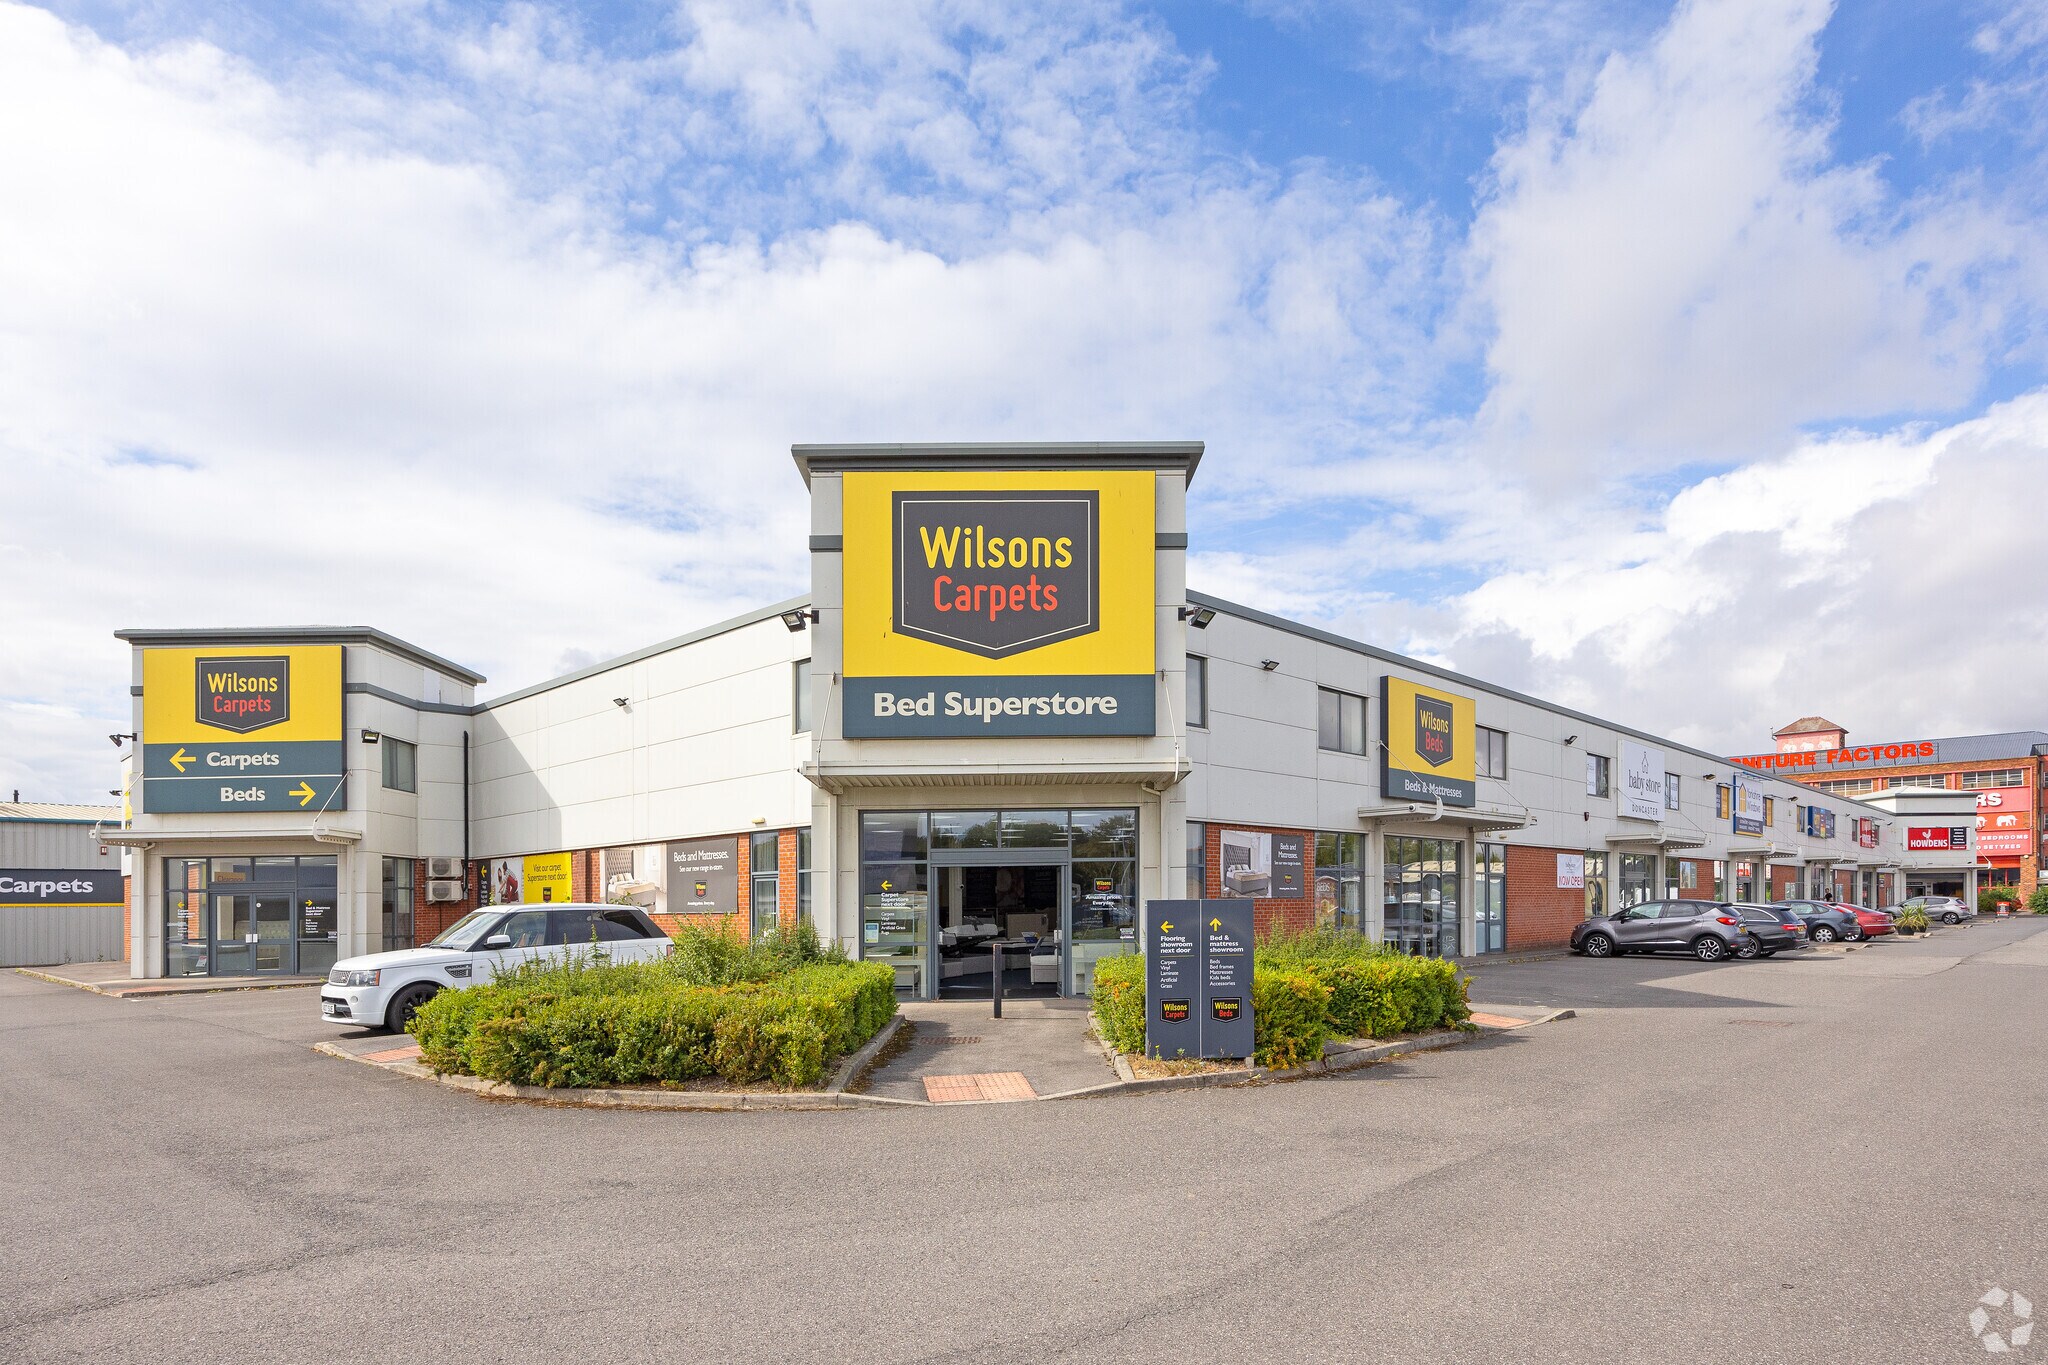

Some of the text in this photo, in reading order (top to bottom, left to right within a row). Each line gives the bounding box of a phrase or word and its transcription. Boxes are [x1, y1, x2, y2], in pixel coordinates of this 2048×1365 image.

[920, 525, 1072, 569] Wilsons
[934, 574, 1058, 621] Carpets
[207, 671, 278, 694] Wilsons
[213, 694, 271, 717] Carpets
[874, 691, 1118, 723] Bed Superstore
[1420, 709, 1449, 734] Wilsons
[1425, 731, 1444, 753] Beds
[206, 750, 280, 771] Carpets
[1827, 742, 1934, 765] FACTORS
[1404, 779, 1462, 798] Beds & Mattresses
[1628, 769, 1645, 796] baby
[1645, 779, 1662, 794] store
[220, 786, 266, 803] Beds
[1632, 804, 1658, 816] DONCASTER
[1280, 842, 1297, 851] Beds and
[1910, 839, 1948, 847] HOWDENS
[673, 850, 729, 862] Beds and Mattresses.
[533, 864, 541, 872] Visit
[549, 863, 561, 873] carpet
[699, 865, 709, 873] range
[0, 877, 93, 897] Carpets
[527, 873, 547, 884] Superstore
[548, 873, 556, 881] next
[1559, 875, 1584, 887] NOW OPEN
[1163, 1003, 1188, 1011] Wilsons
[1214, 1001, 1238, 1010] Wilsons
[1165, 1011, 1185, 1019] Carpets
